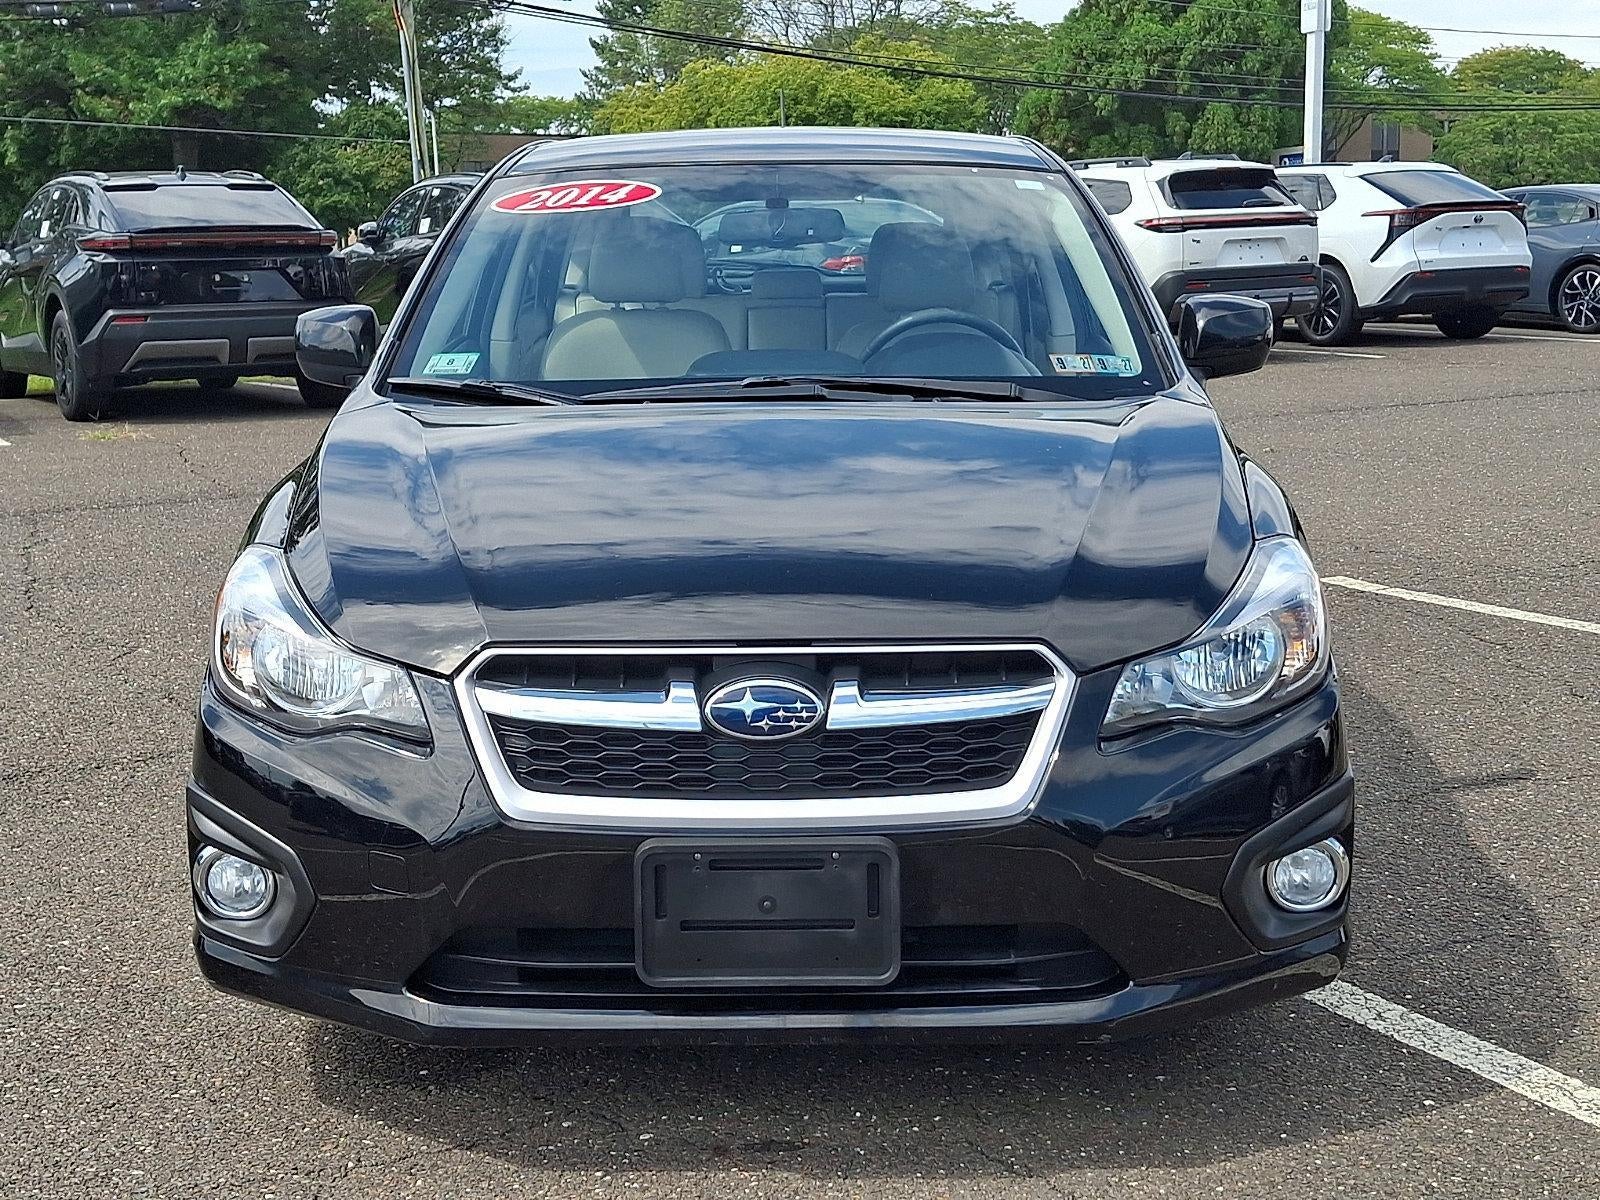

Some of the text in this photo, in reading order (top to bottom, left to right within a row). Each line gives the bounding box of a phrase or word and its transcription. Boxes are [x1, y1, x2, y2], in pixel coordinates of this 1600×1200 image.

[514, 184, 637, 211] 2014
[1056, 357, 1092, 370] 9 27
[1097, 357, 1133, 371] 9 27
